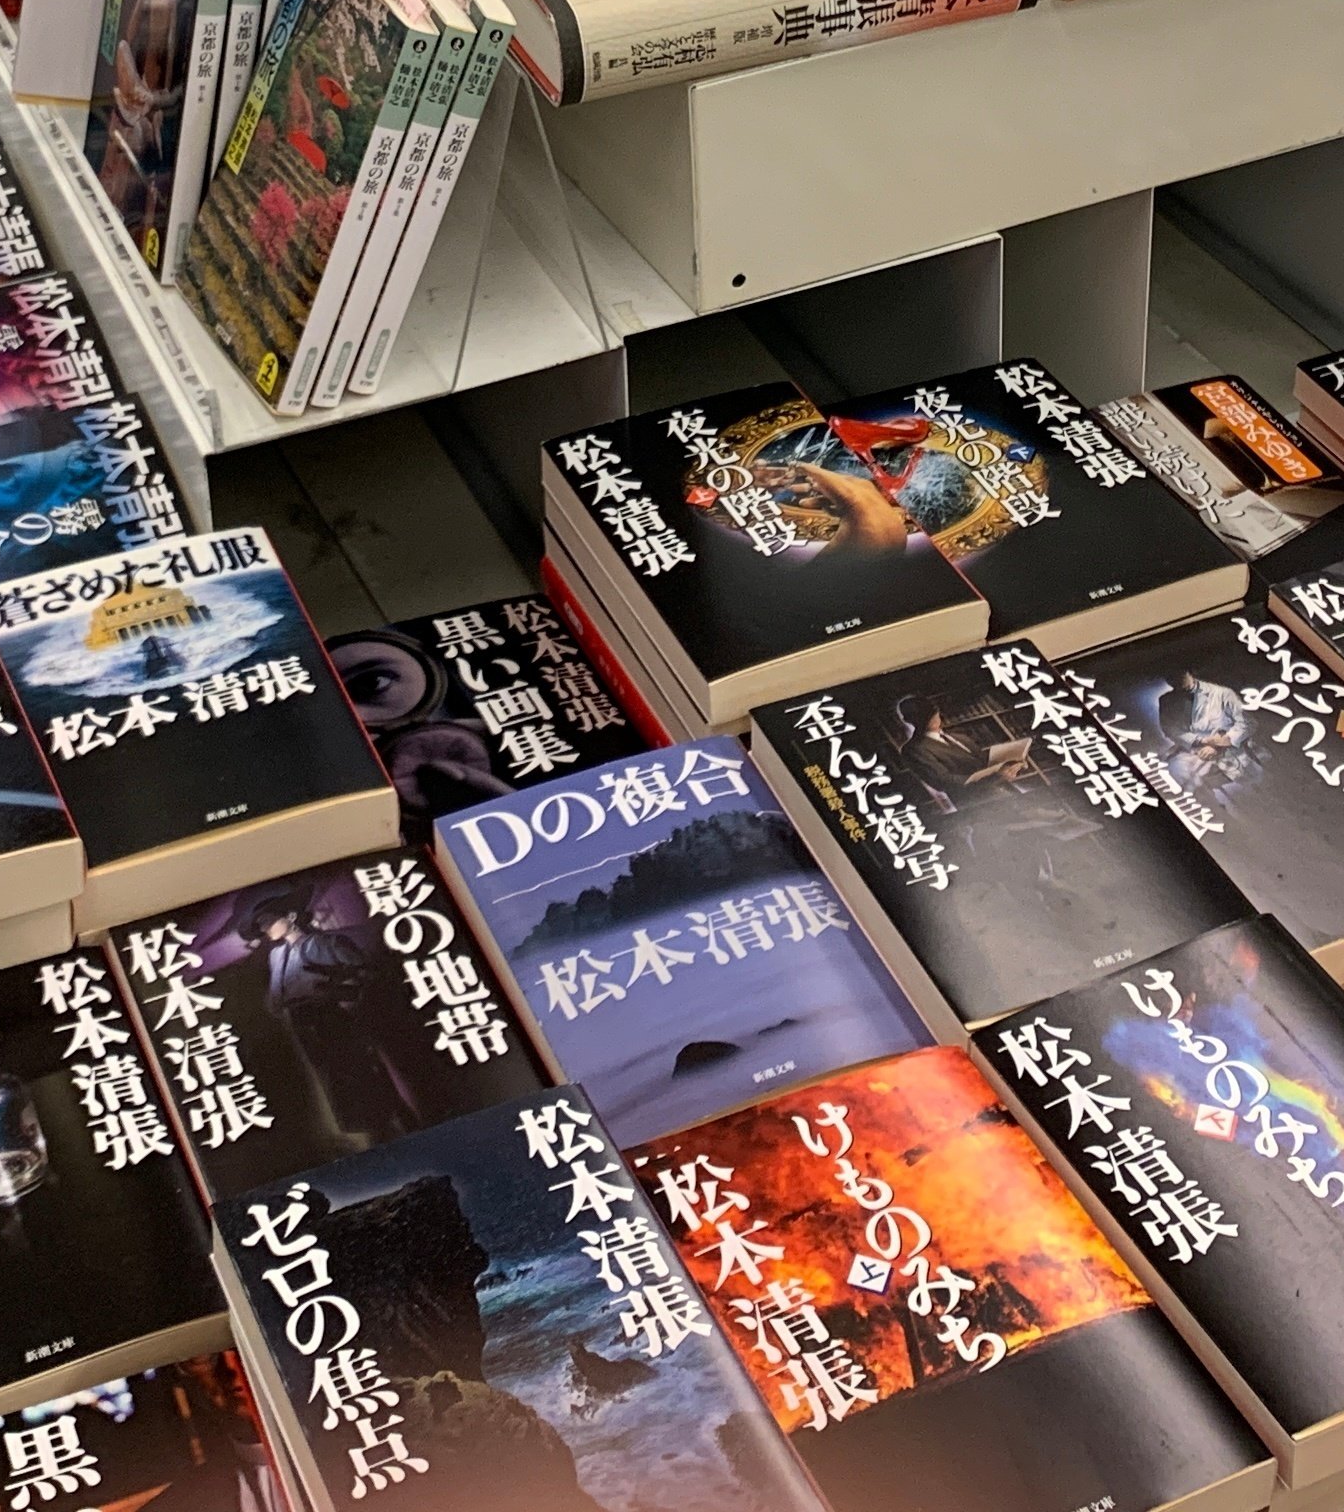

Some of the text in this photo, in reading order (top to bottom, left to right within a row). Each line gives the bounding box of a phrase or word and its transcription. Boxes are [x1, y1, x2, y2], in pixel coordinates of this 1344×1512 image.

[196, 22, 216, 79] 京都の旅
[233, 10, 254, 68] 京都の旅
[630, 44, 717, 76] 志村有弘
[363, 134, 393, 196] 京都の旅
[397, 131, 430, 192] 京都の旅
[436, 122, 469, 183] 京都の旅
[657, 407, 808, 558] 夜光の階段
[905, 384, 1062, 530] 夜光の階段
[992, 364, 1148, 489] 松本清張
[1198, 383, 1307, 479] 宮部みゆき
[556, 434, 698, 577] 松本清張
[824, 618, 862, 636] 新潮文庫
[1087, 584, 1125, 600] 新潮文庫
[45, 654, 318, 761] 松本清張
[431, 610, 580, 780] 黒い画集
[501, 599, 626, 734] 松本清張
[980, 645, 1161, 819] 松本清張
[205, 804, 250, 822] 新潮文庫
[448, 746, 755, 882] Dの複合
[784, 695, 960, 891] 歪んだ複写
[351, 858, 511, 1068] 影の地帯
[532, 879, 853, 1025] 松本清張
[1092, 948, 1135, 968] 新潮文庫
[31, 955, 177, 1171] 松本清張
[120, 918, 275, 1150] 松本清張
[751, 1059, 798, 1086] 新潮文庫
[994, 1014, 1242, 1267] 松本清張
[513, 1096, 713, 1359] 松本清張
[650, 1151, 882, 1434] 松本清張
[790, 1101, 1010, 1378] けものみち
[24, 1335, 76, 1365] 新潮文庫
[239, 1179, 432, 1502] ゼロの焦点
